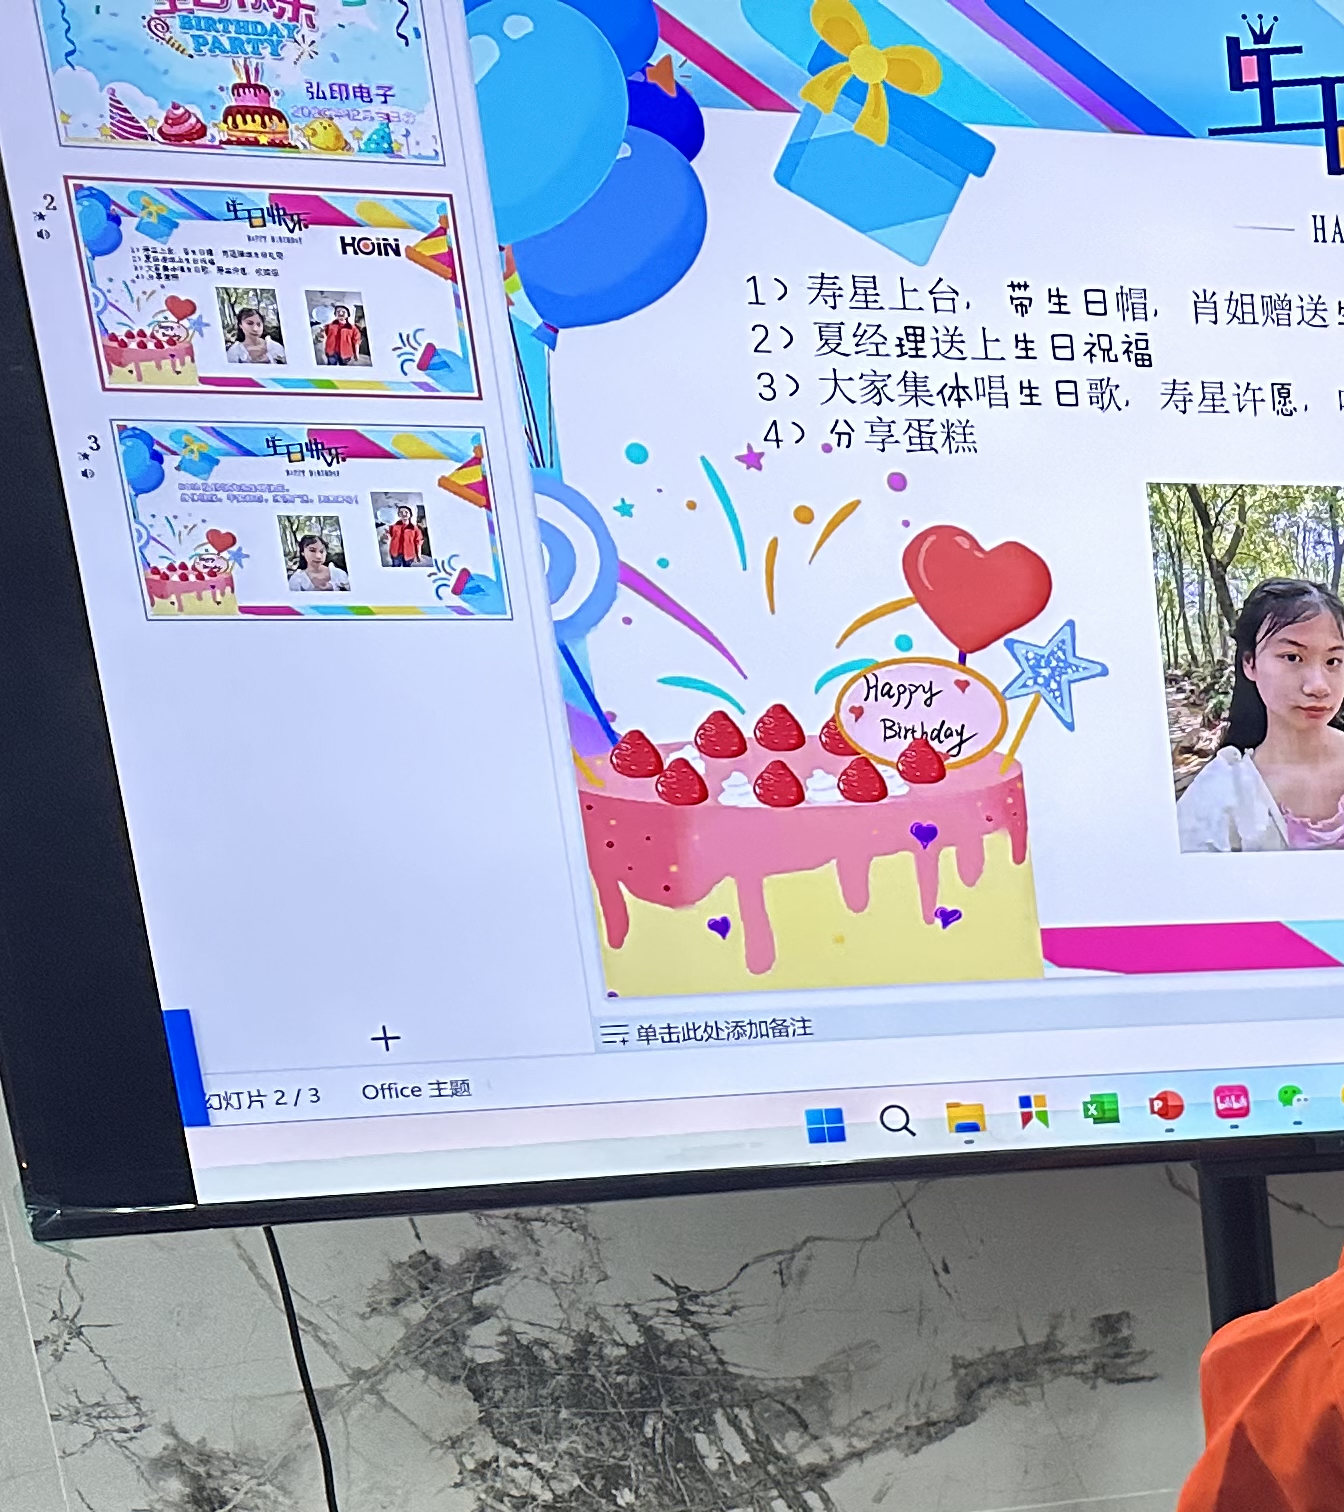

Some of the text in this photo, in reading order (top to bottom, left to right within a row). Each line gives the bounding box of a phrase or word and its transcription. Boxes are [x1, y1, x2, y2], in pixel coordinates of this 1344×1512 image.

[177, 14, 300, 39] BIRTHDAY
[190, 34, 284, 57] PARTY
[304, 81, 396, 104] 弘印电子
[44, 195, 57, 212] 2
[88, 435, 100, 452] 3
[863, 672, 943, 710] Happy
[880, 717, 979, 757] Birthday
[636, 1016, 814, 1048] 单击此处添加备注
[275, 1088, 288, 1107] 2
[309, 1086, 322, 1105] 3
[362, 1078, 472, 1101] Office 主题
